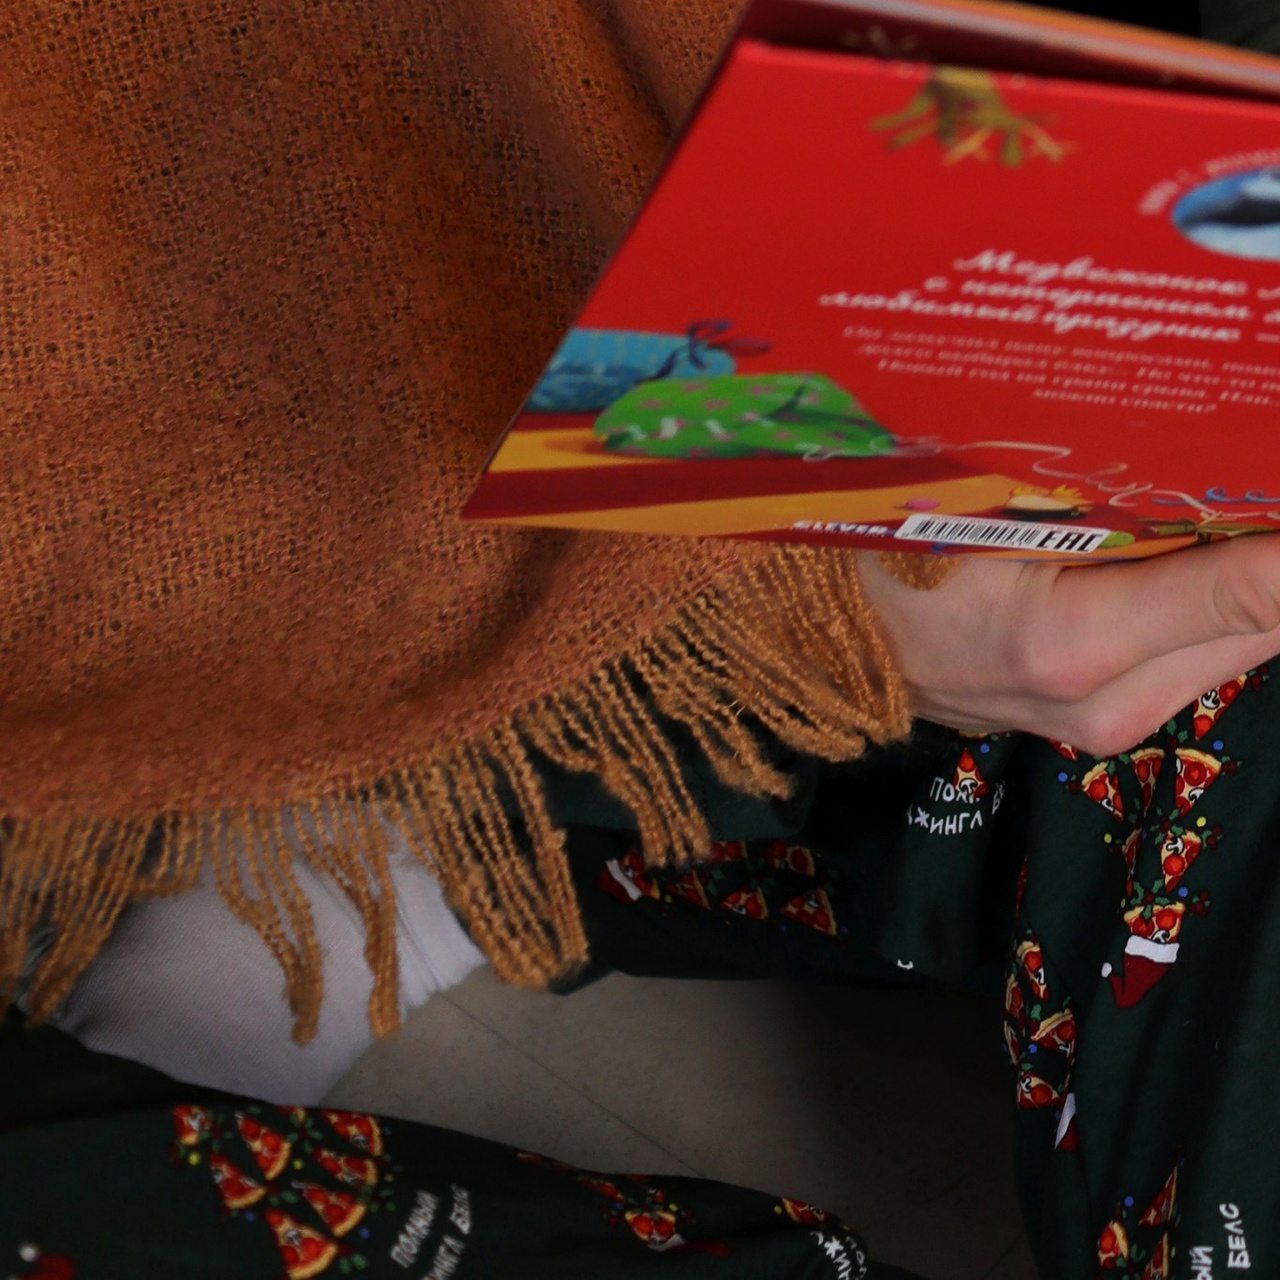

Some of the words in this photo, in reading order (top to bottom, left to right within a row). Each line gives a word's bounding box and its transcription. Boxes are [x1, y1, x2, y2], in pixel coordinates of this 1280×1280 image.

[953, 248, 1248, 297] Медвежонок
[818, 288, 1040, 323] любимый
[1043, 310, 1241, 342] праздник
[960, 280, 1253, 320] нетерпением
[391, 1189, 439, 1268] ПОЛНЫЙ
[1219, 1203, 1251, 1269] БЕЛС
